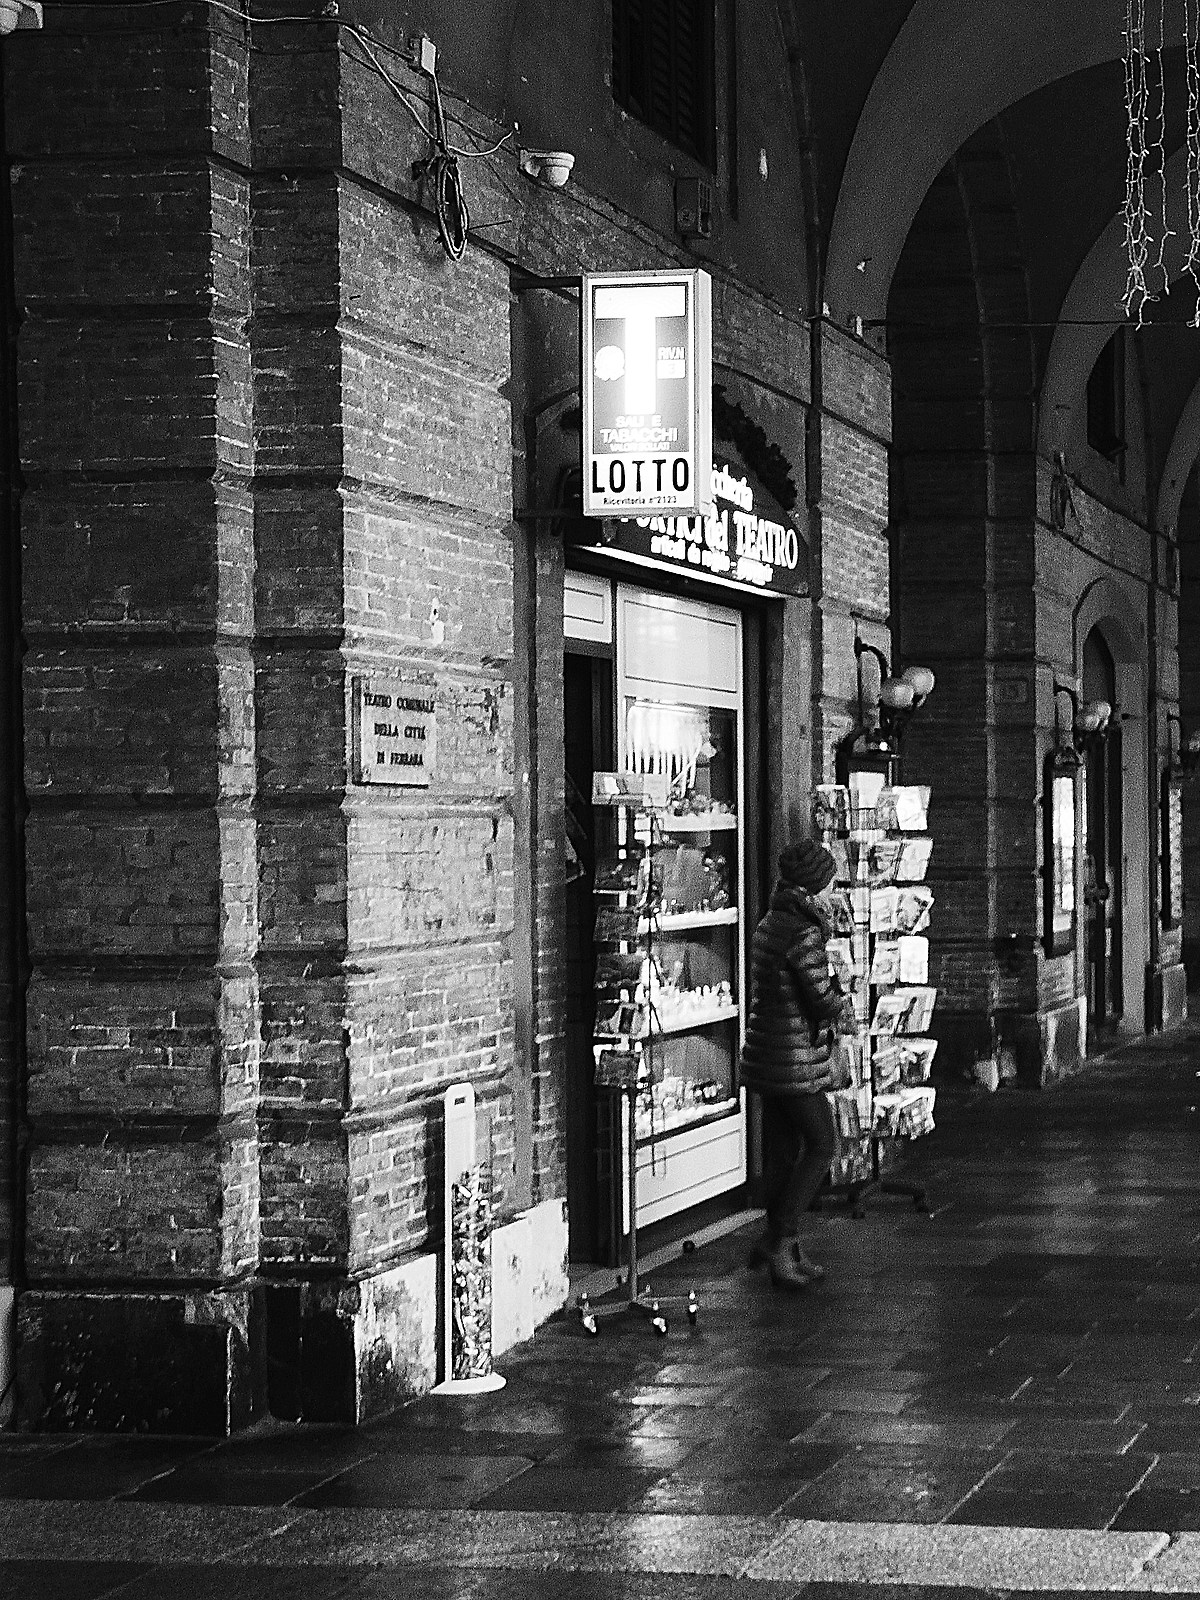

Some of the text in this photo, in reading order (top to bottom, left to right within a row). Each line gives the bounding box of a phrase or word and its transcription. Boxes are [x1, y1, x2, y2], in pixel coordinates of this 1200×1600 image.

[615, 414, 662, 428] SALI E
[599, 427, 678, 444] TABACCHI
[592, 457, 689, 494] LOTTO
[733, 510, 798, 569] TEATRO
[363, 693, 434, 713] TEATRO COMUNALE
[374, 723, 398, 736] DELLA
[390, 753, 423, 765] FERRARA
